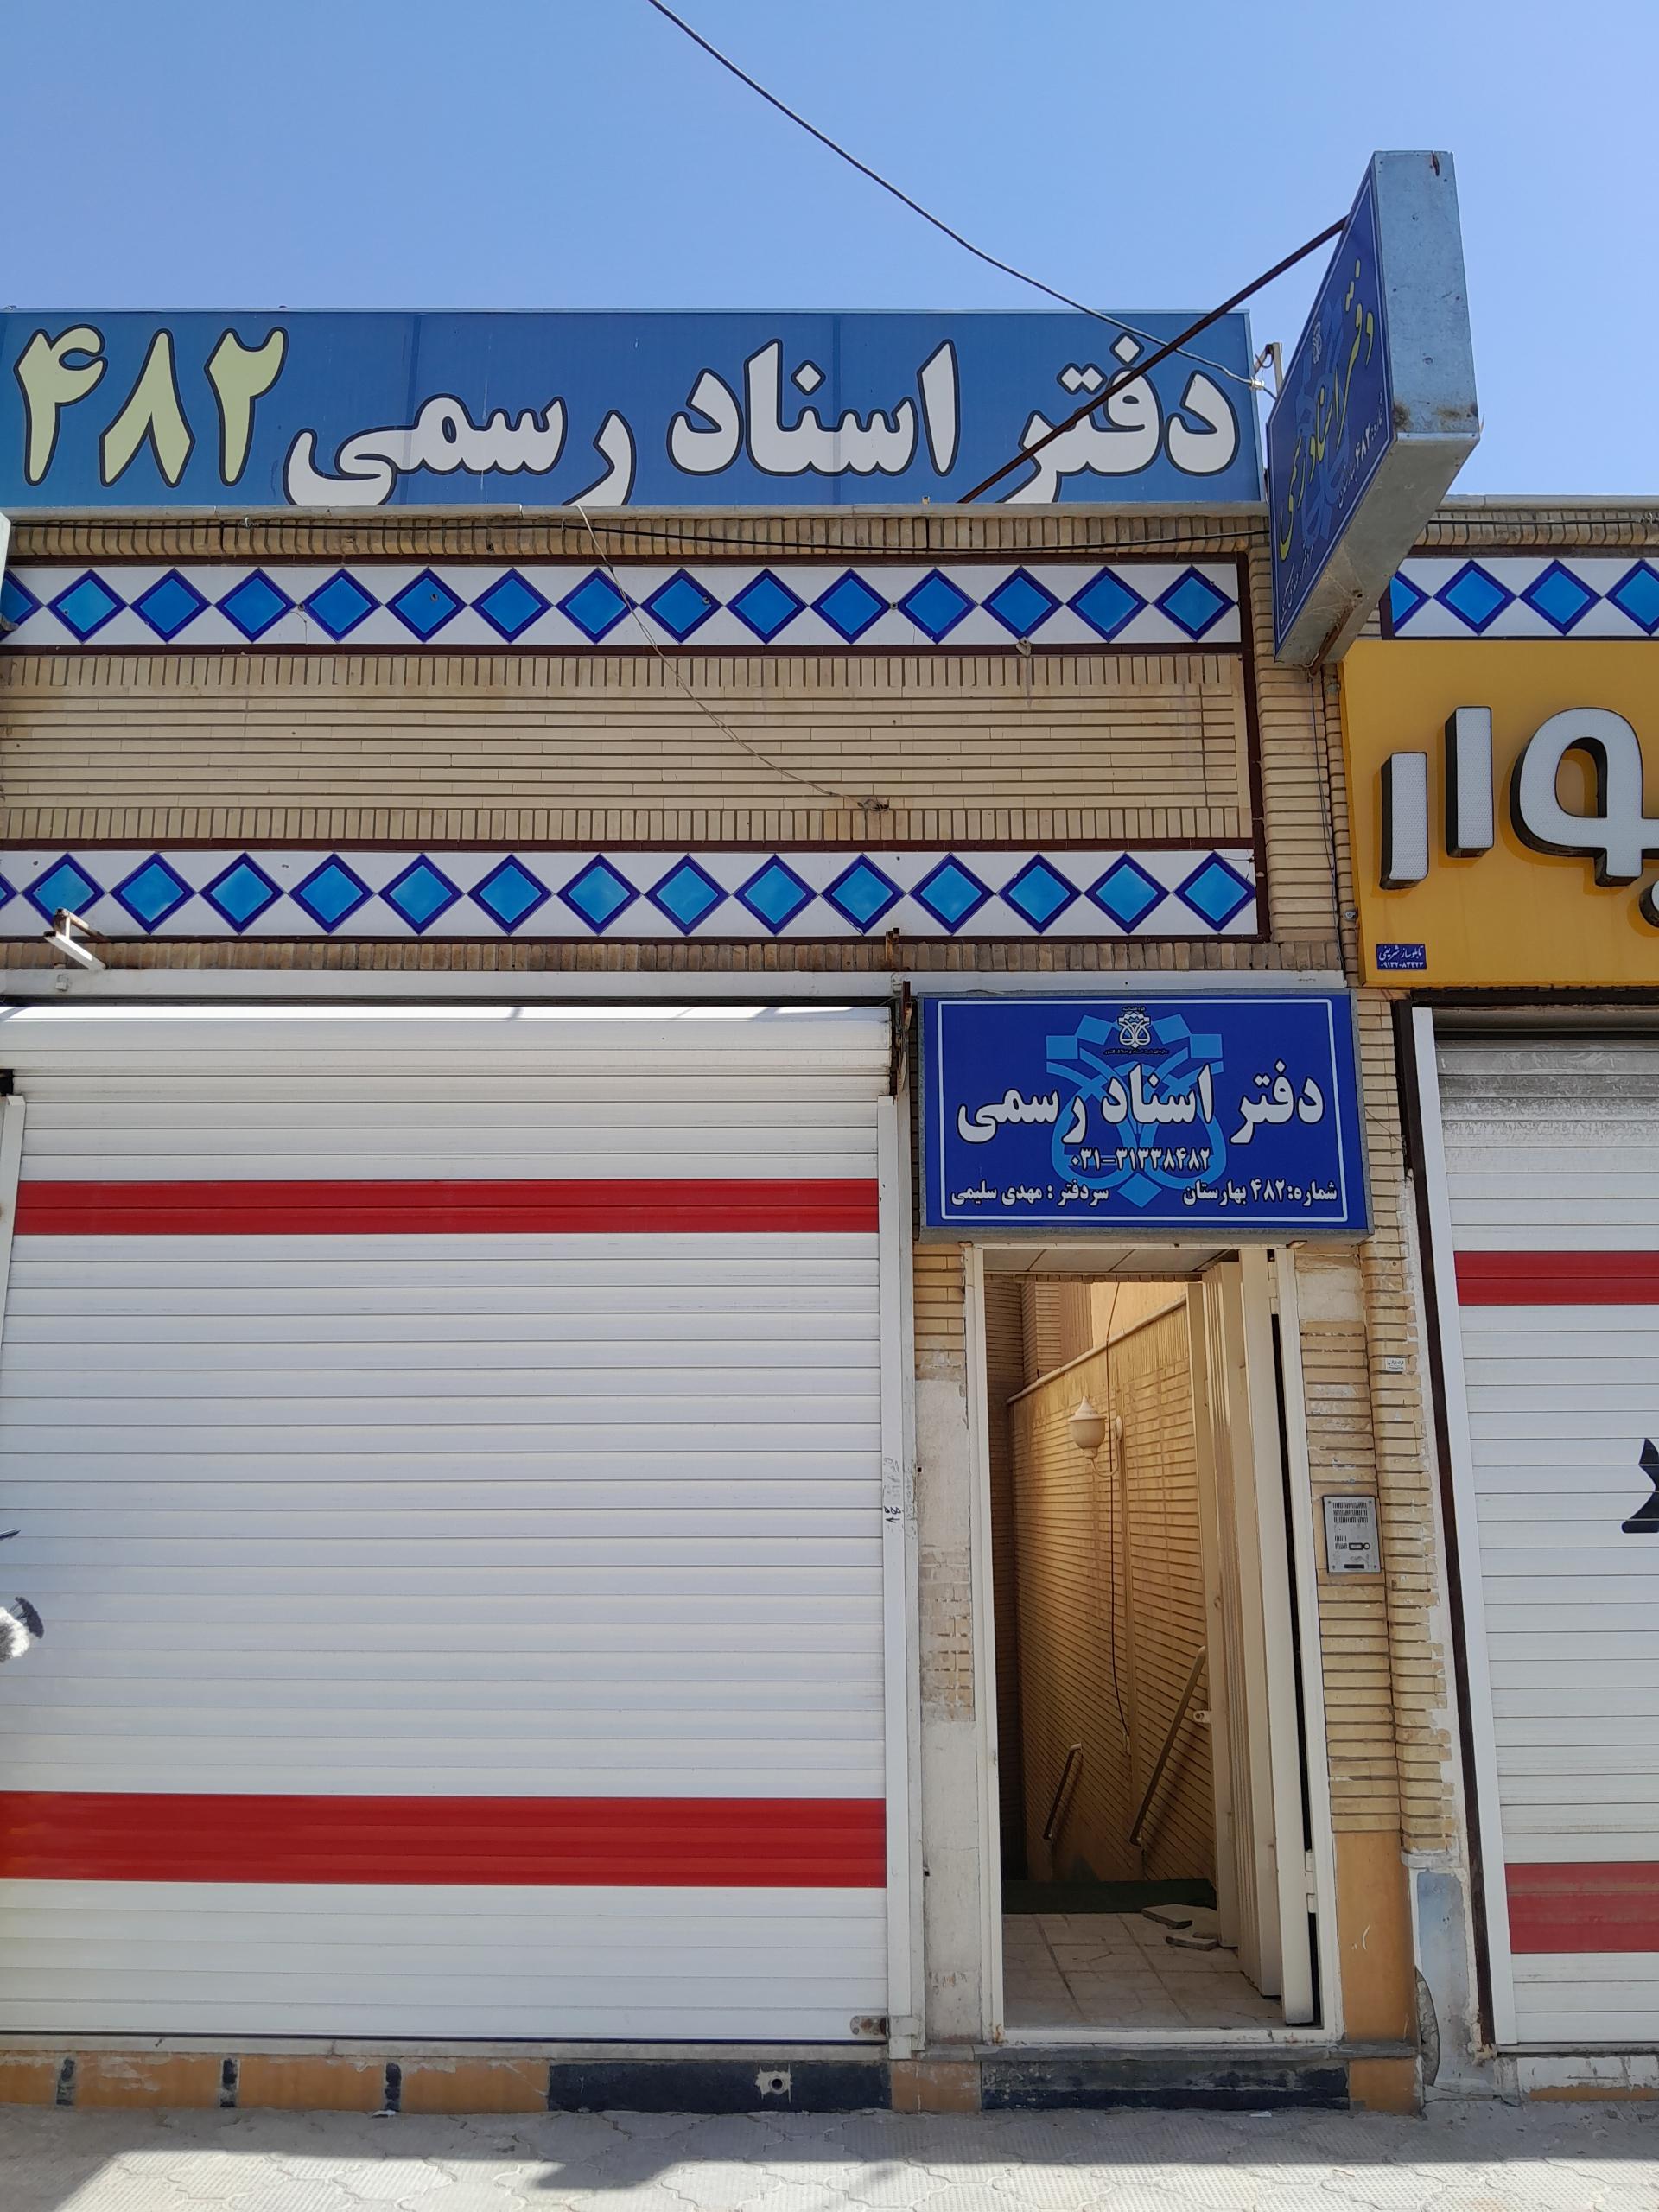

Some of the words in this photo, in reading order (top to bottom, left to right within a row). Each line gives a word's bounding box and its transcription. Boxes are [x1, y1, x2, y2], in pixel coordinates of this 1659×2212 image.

[13, 323, 289, 486] ۴۸۲
[667, 338, 961, 477] اسناد
[1336, 258, 1375, 451] دفتر
[283, 392, 636, 506] رسمی
[1000, 332, 1239, 506] دفتر
[1308, 365, 1340, 485] اسناد
[1279, 435, 1306, 562] رسمی
[957, 1087, 1088, 1144] رسمی
[1101, 1062, 1214, 1125] اسناد
[1229, 1058, 1325, 1145] دفتر
[950, 1179, 998, 1206] سلیمی
[1001, 1185, 1043, 1206] مهدی
[1182, 1179, 1248, 1206] بهارستان
